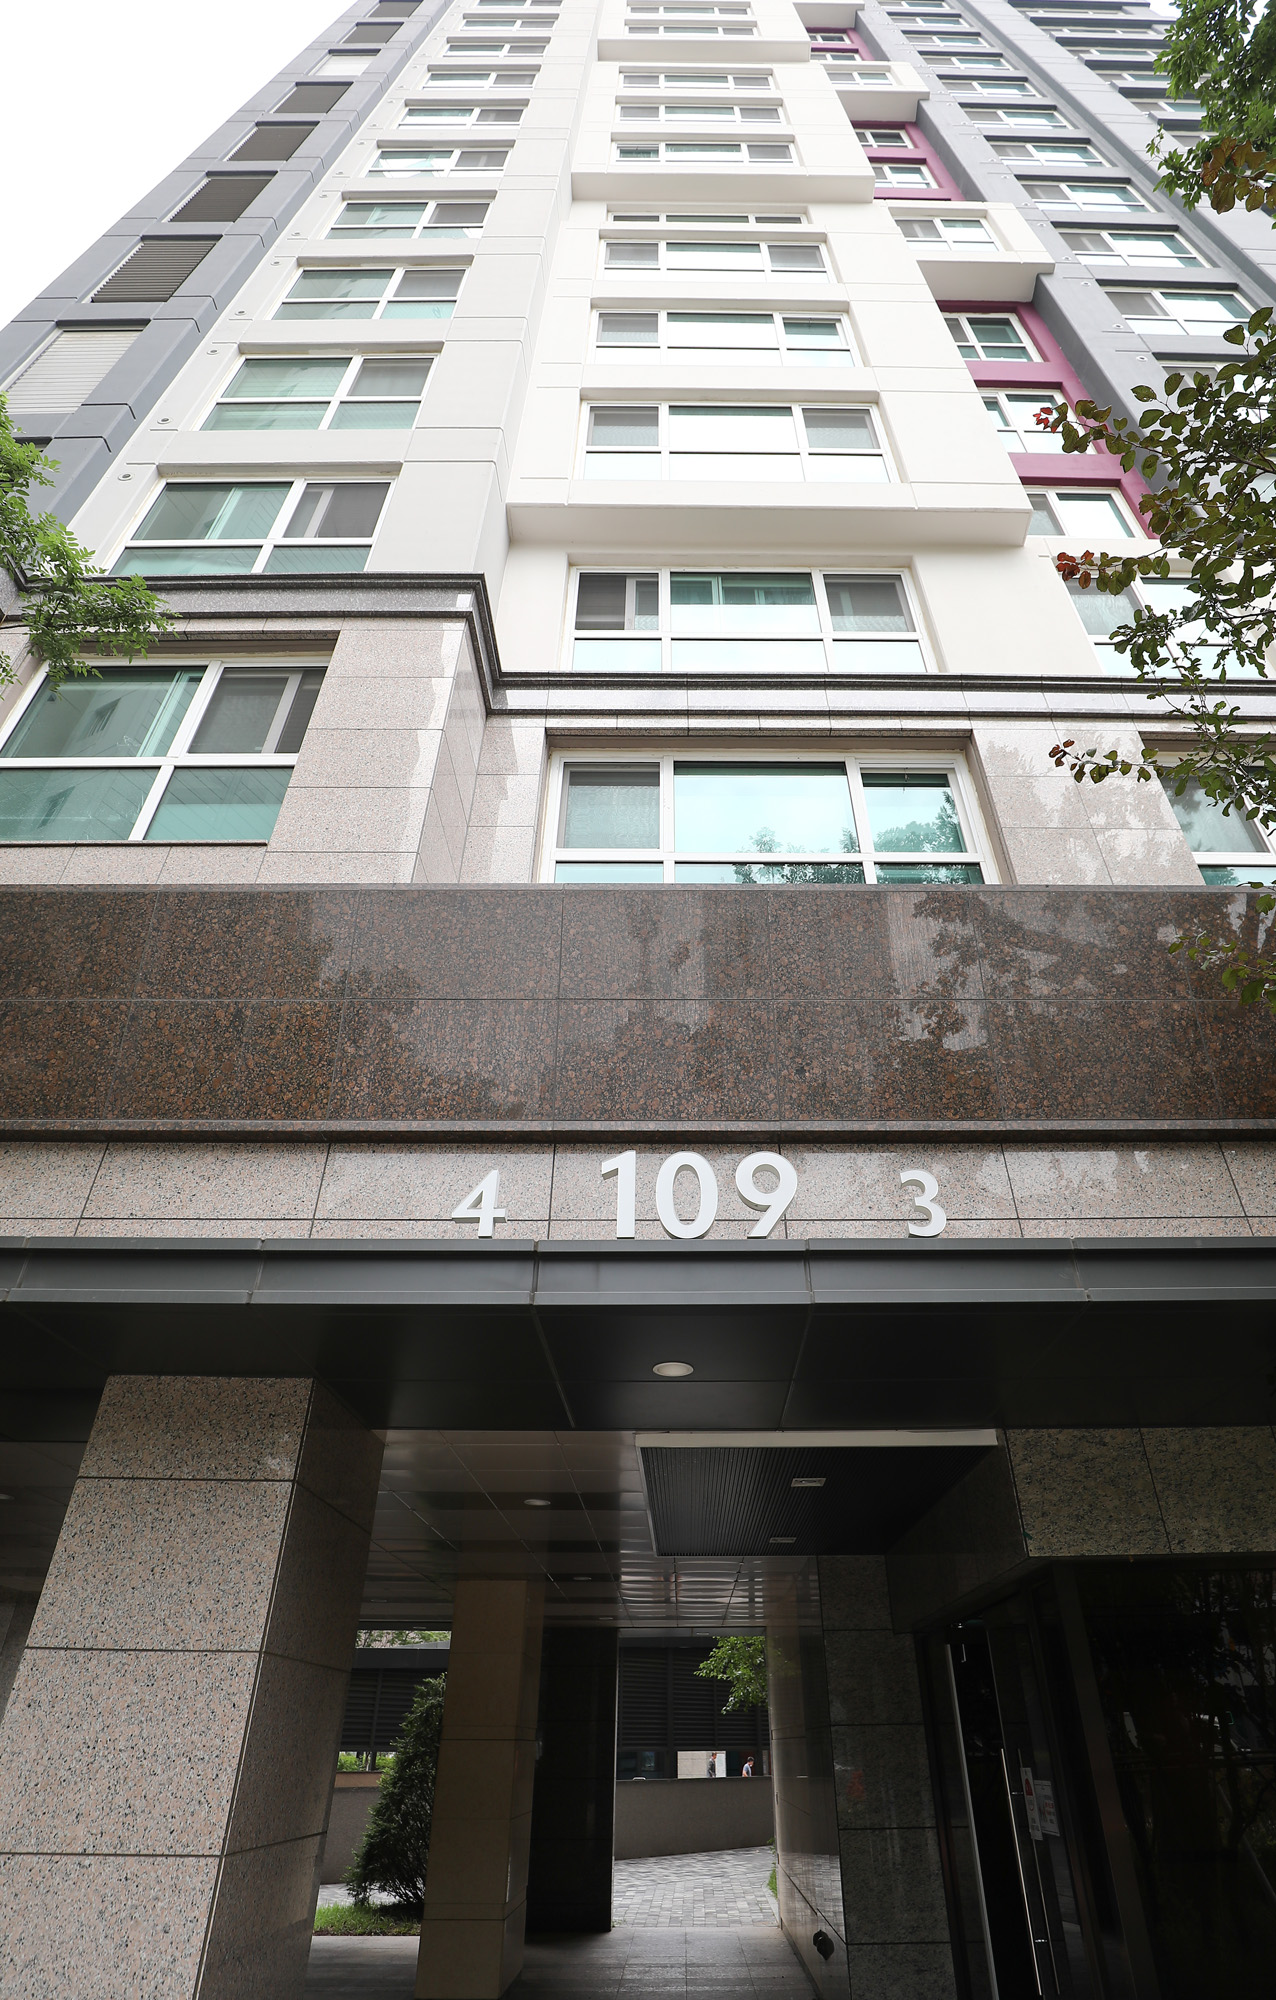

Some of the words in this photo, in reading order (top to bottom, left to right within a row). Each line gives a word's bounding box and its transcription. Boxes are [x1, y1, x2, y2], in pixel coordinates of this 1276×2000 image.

[452, 1169, 507, 1238] 4
[601, 1149, 798, 1239] 109
[900, 1169, 947, 1238] 3
